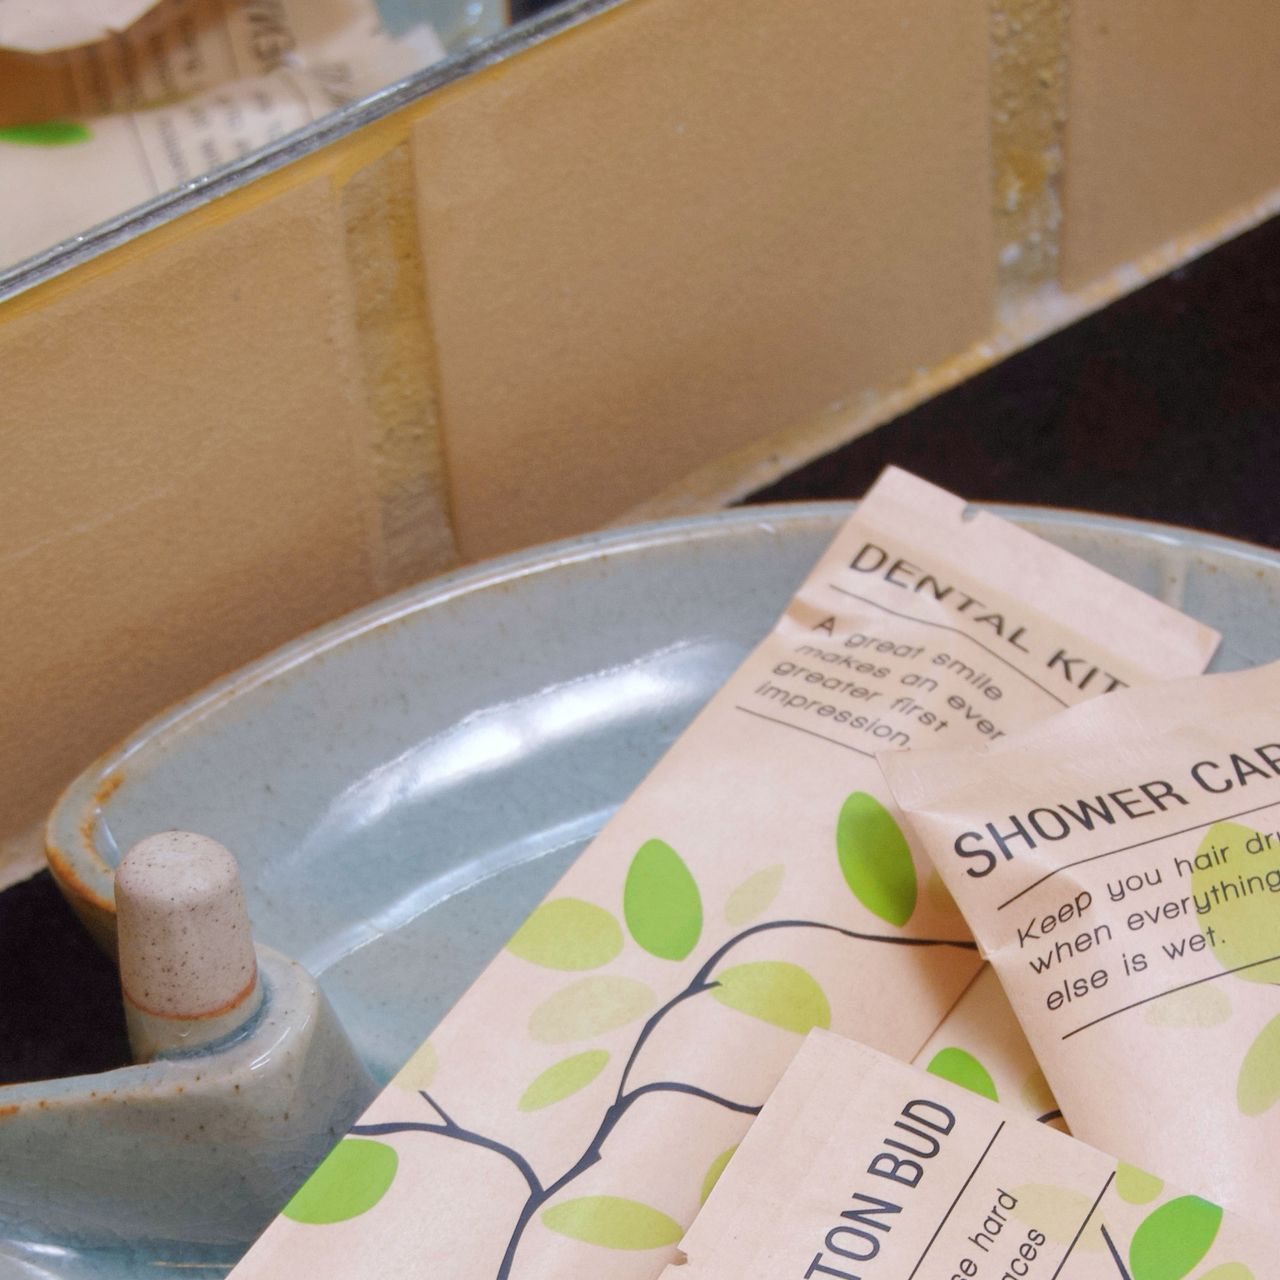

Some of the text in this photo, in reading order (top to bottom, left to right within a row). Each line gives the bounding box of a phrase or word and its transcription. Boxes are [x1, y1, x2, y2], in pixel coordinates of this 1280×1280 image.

[848, 541, 1032, 654] DENTAL
[772, 658, 949, 733] greater first
[794, 643, 1008, 741] makes an ever
[813, 614, 1004, 702] A great smile
[954, 778, 1191, 880] SHOWER
[1016, 888, 1094, 949] Keep
[1106, 866, 1163, 902] you
[1173, 843, 1230, 879] hair
[1028, 921, 1113, 975] when
[1045, 924, 1227, 1012] else is wet.
[866, 1098, 957, 1190] BUD
[967, 1187, 1020, 1253] hard
